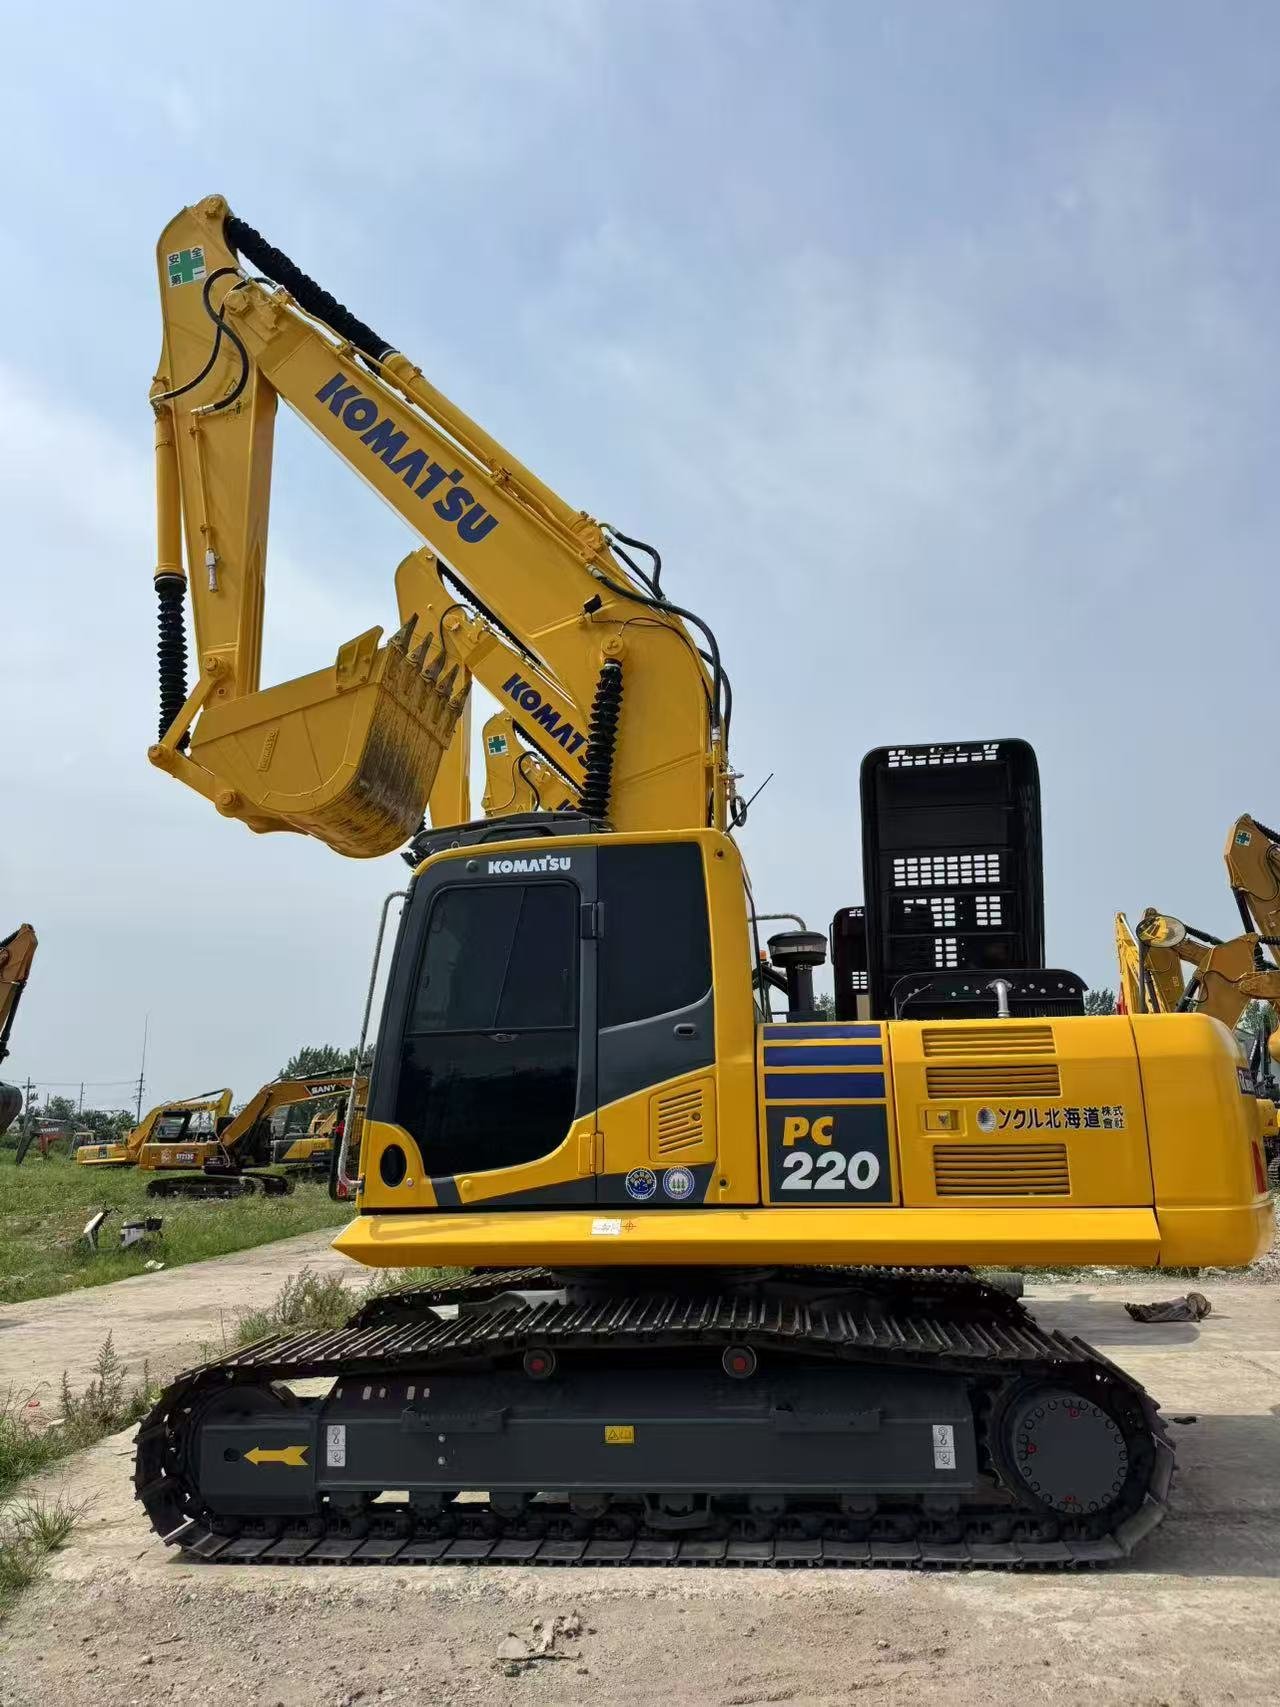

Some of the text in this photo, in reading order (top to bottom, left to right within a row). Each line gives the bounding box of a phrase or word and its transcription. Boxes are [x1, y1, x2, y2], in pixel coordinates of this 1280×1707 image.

[315, 372, 499, 543] KOMATSU
[502, 673, 591, 768] KOMAT
[488, 855, 571, 874] KOMATSU
[311, 1084, 336, 1095] SANY
[783, 1116, 833, 1146] PC
[781, 1151, 879, 1190] 220
